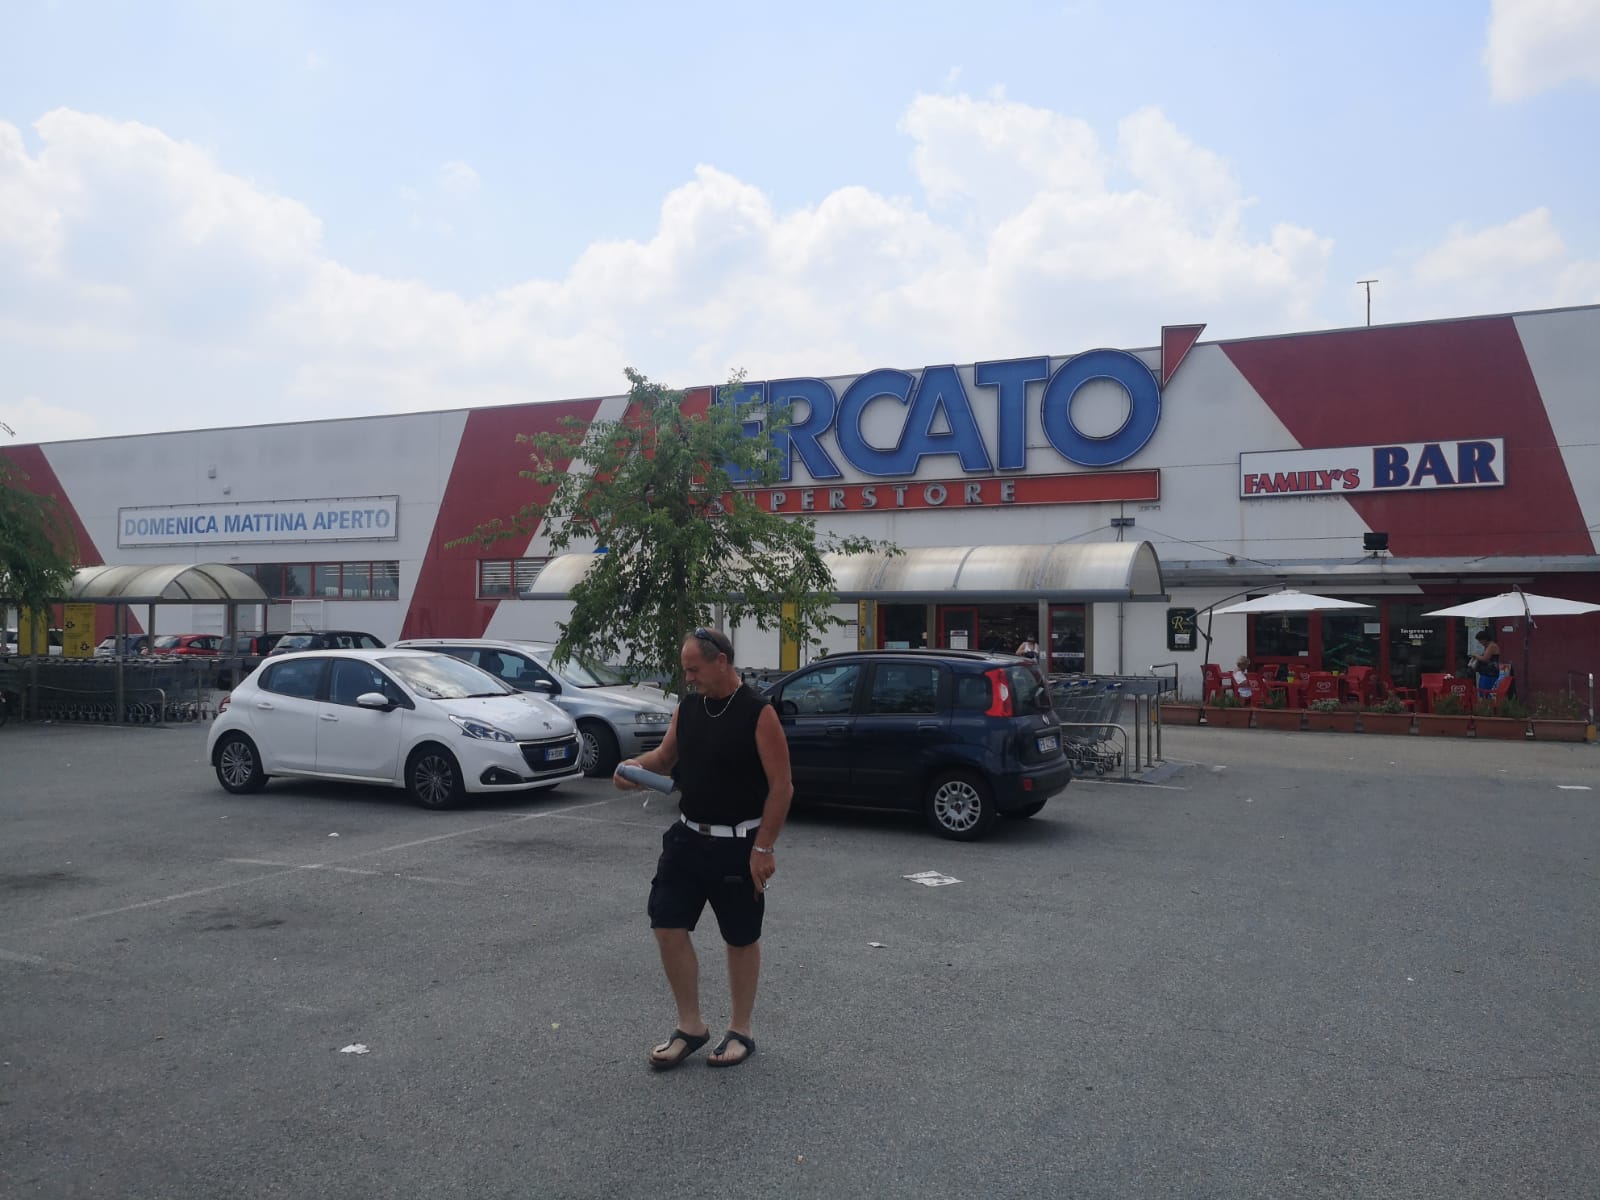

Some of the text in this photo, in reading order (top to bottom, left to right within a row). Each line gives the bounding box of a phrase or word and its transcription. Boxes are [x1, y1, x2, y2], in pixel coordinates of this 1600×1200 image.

[1243, 441, 1500, 494] FAMILY'S BAR
[125, 509, 391, 537] DOMENICA MATTINA APERTO
